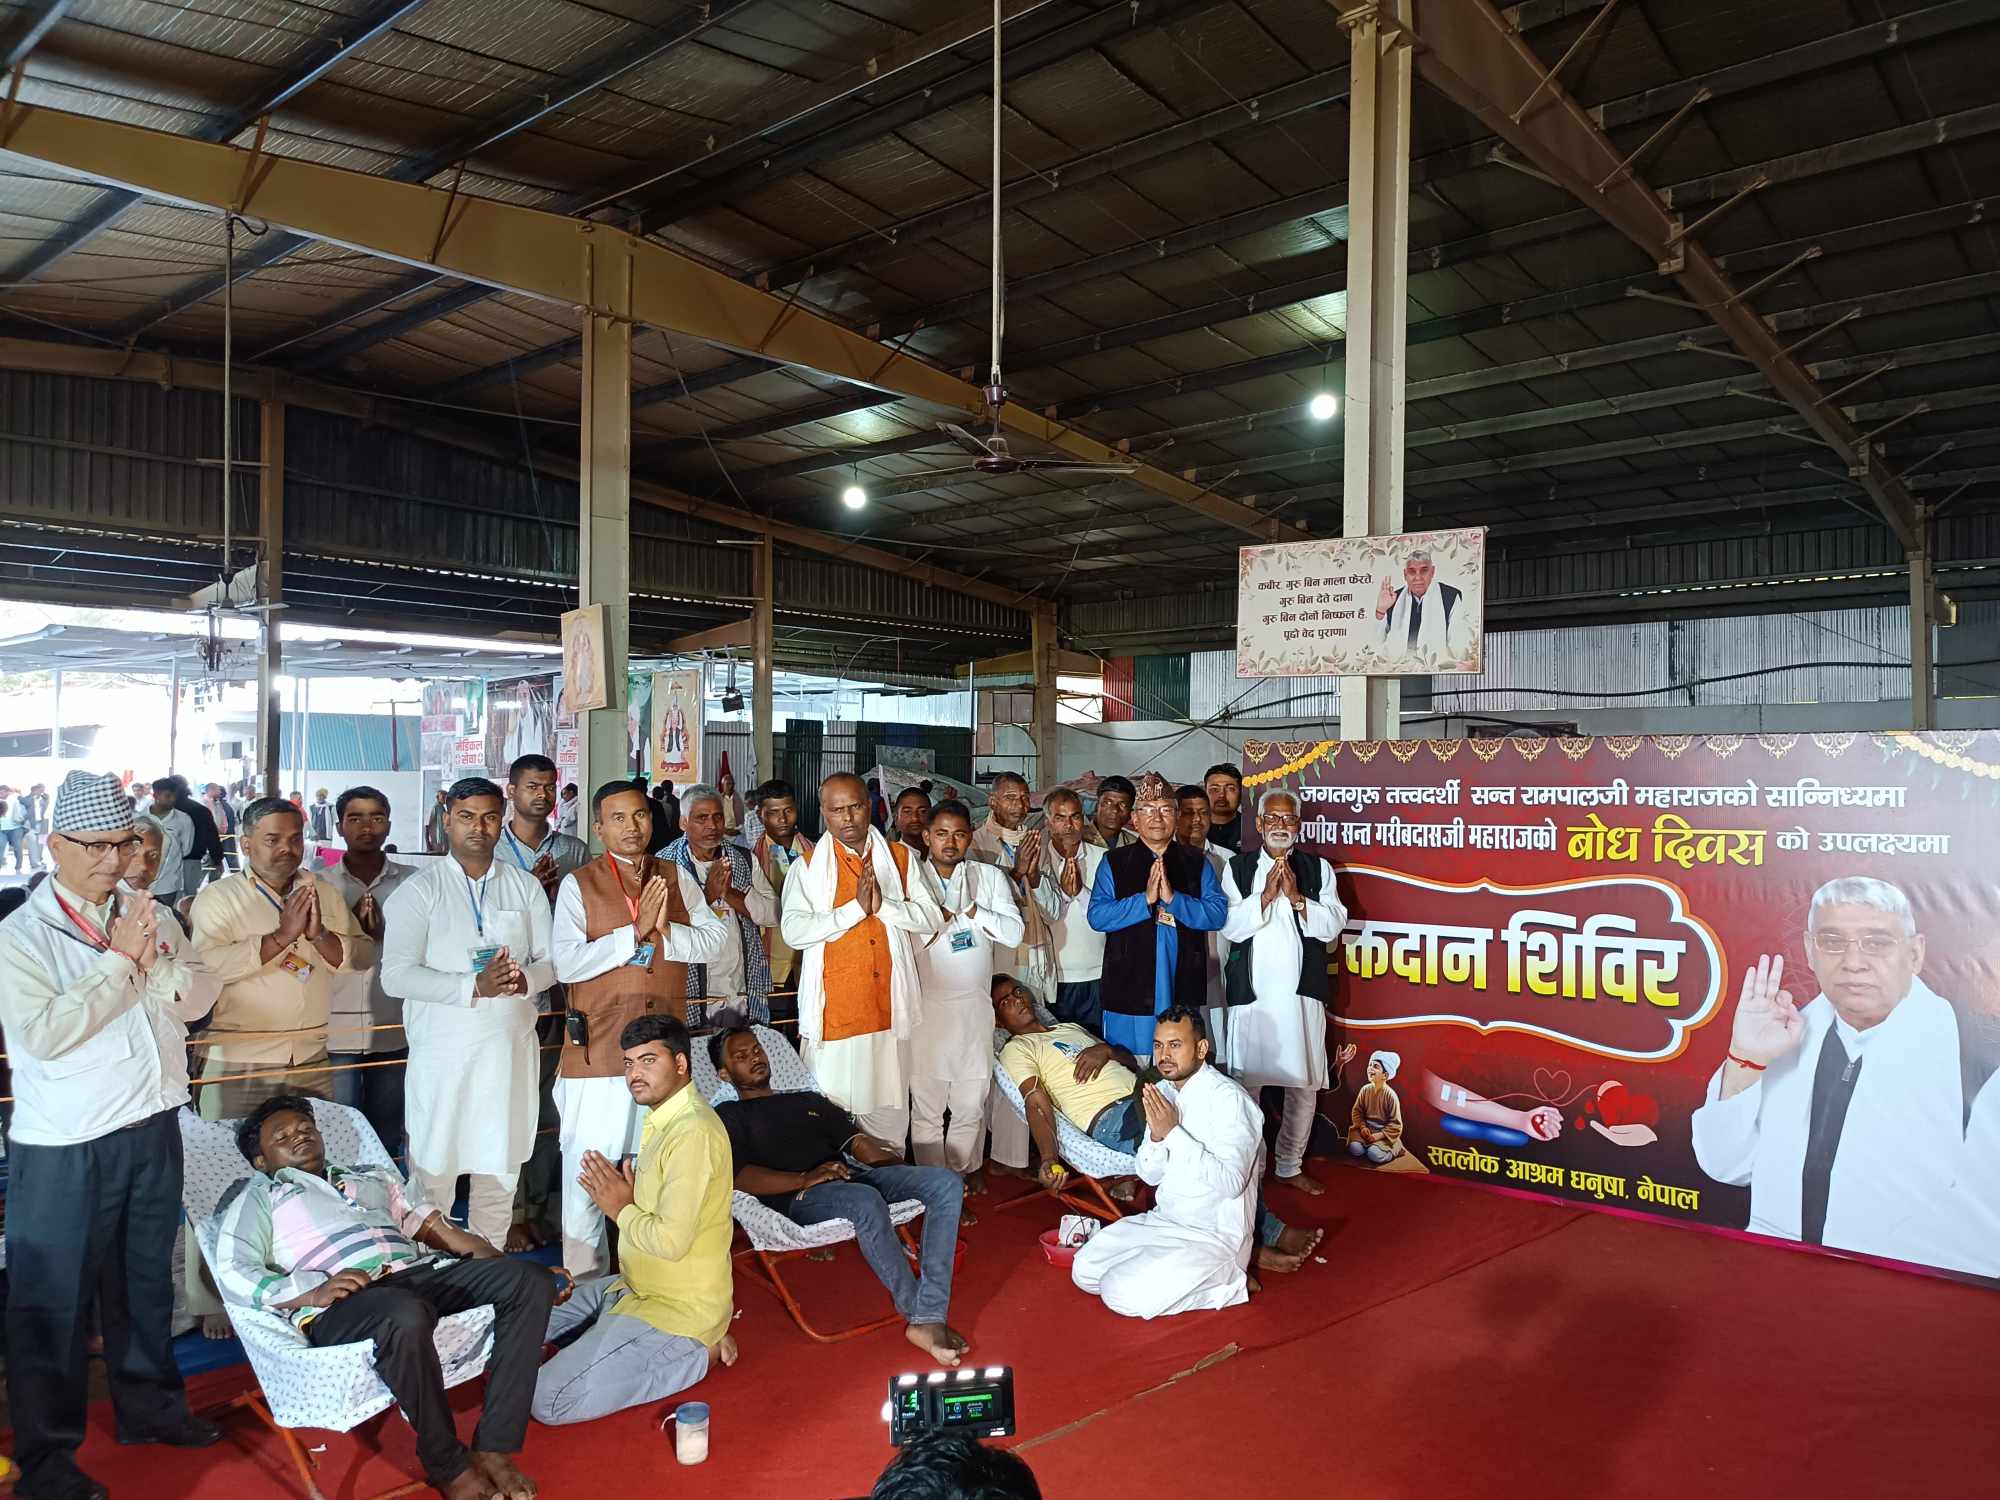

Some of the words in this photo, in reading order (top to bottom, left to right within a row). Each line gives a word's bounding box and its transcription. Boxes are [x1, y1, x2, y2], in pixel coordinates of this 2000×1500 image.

[1323, 575, 1346, 586] माला
[1316, 593, 1331, 603] देते
[1302, 627, 1314, 638] वेद
[1471, 786, 1515, 807] सन्त
[1520, 778, 1629, 807] रामपालजी
[1635, 779, 1758, 808] महाराजको
[1765, 777, 1907, 808] सान्निध्यमा
[1296, 814, 1338, 844] रणीय
[1341, 822, 1372, 846] सन्त
[1375, 815, 1464, 849] गरीबदासजी
[1468, 817, 1558, 851] महाराजको
[1567, 812, 1642, 862] बोध
[1651, 813, 1767, 869] दिवस
[1776, 826, 1810, 851] को
[1818, 832, 1951, 855] उपलक्ष्यमा
[1501, 909, 1687, 1008] शिविर
[1427, 1145, 1501, 1174] सतलोक
[1505, 1158, 1565, 1187] आश्रम
[1636, 1175, 1700, 1211] नेपाल
